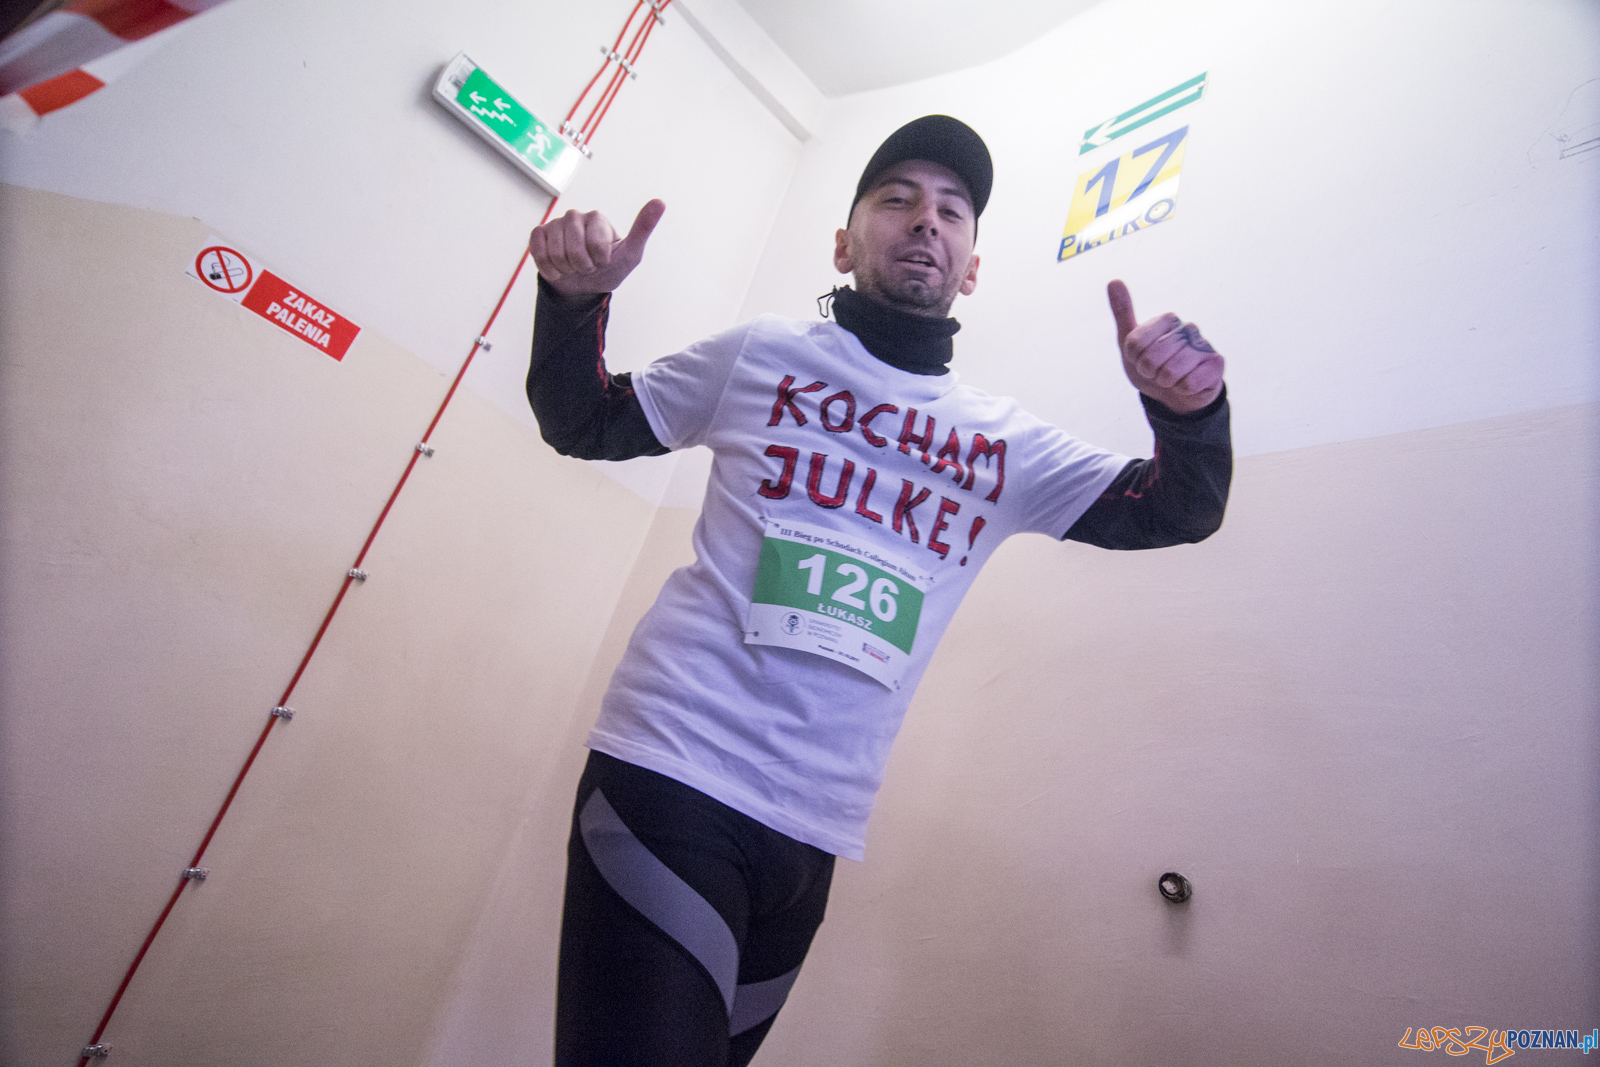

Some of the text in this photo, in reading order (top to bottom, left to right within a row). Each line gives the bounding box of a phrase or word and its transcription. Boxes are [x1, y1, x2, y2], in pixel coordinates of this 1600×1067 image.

[1084, 124, 1189, 218] 17
[266, 301, 331, 348] PALENIA
[283, 290, 336, 329] ZAKAZ
[767, 374, 1007, 505] KOCHAM
[757, 444, 987, 567] JULKE!
[798, 553, 900, 623] 126
[817, 602, 873, 631] ŁUKASZ
